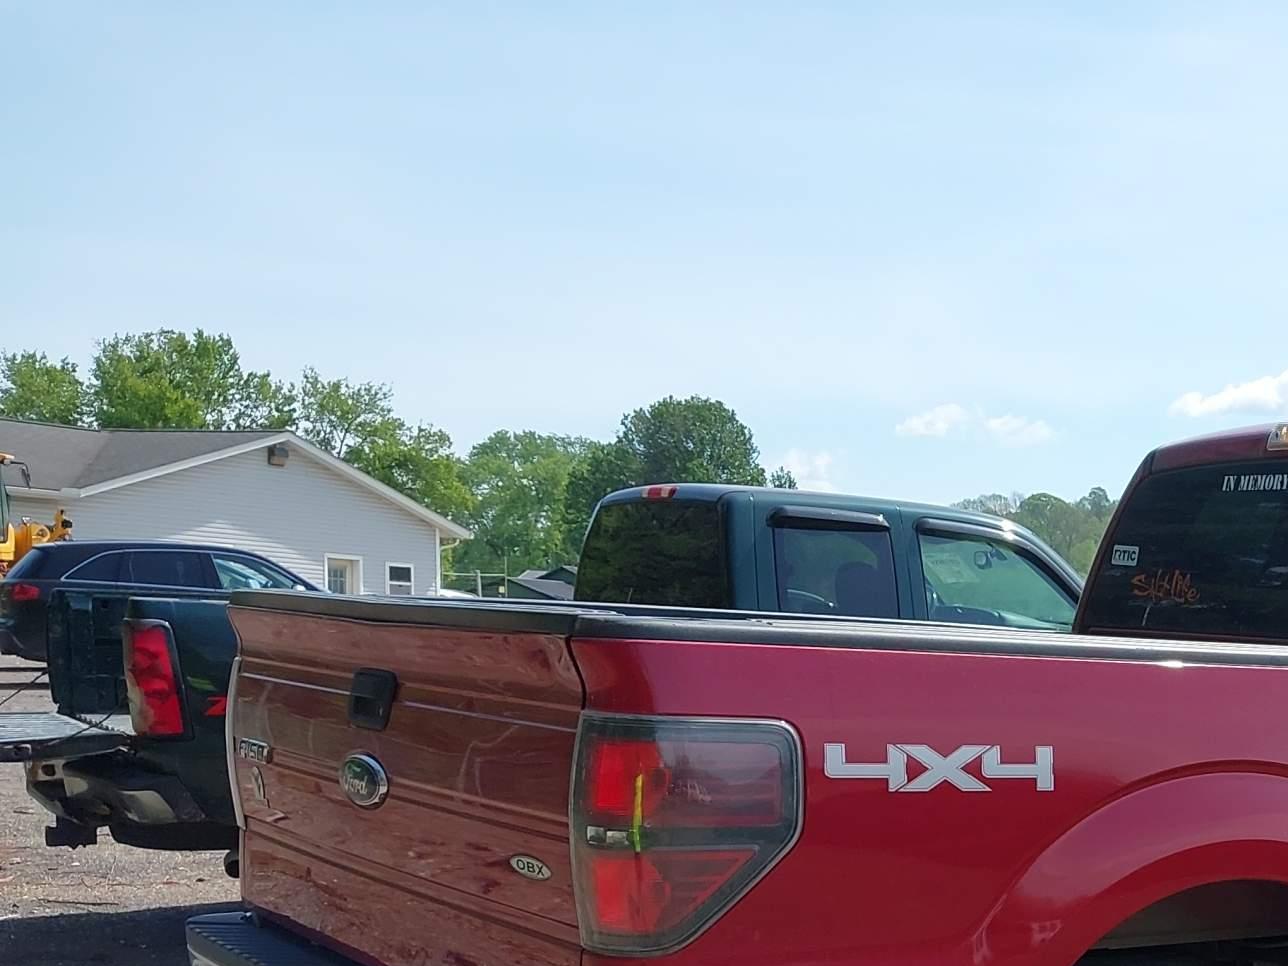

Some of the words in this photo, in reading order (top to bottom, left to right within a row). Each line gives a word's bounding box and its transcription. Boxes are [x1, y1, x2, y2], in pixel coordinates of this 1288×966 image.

[1222, 475, 1236, 491] IN
[1114, 549, 1137, 562] RTIC
[340, 762, 369, 795] Ford
[516, 858, 545, 877] OBX
